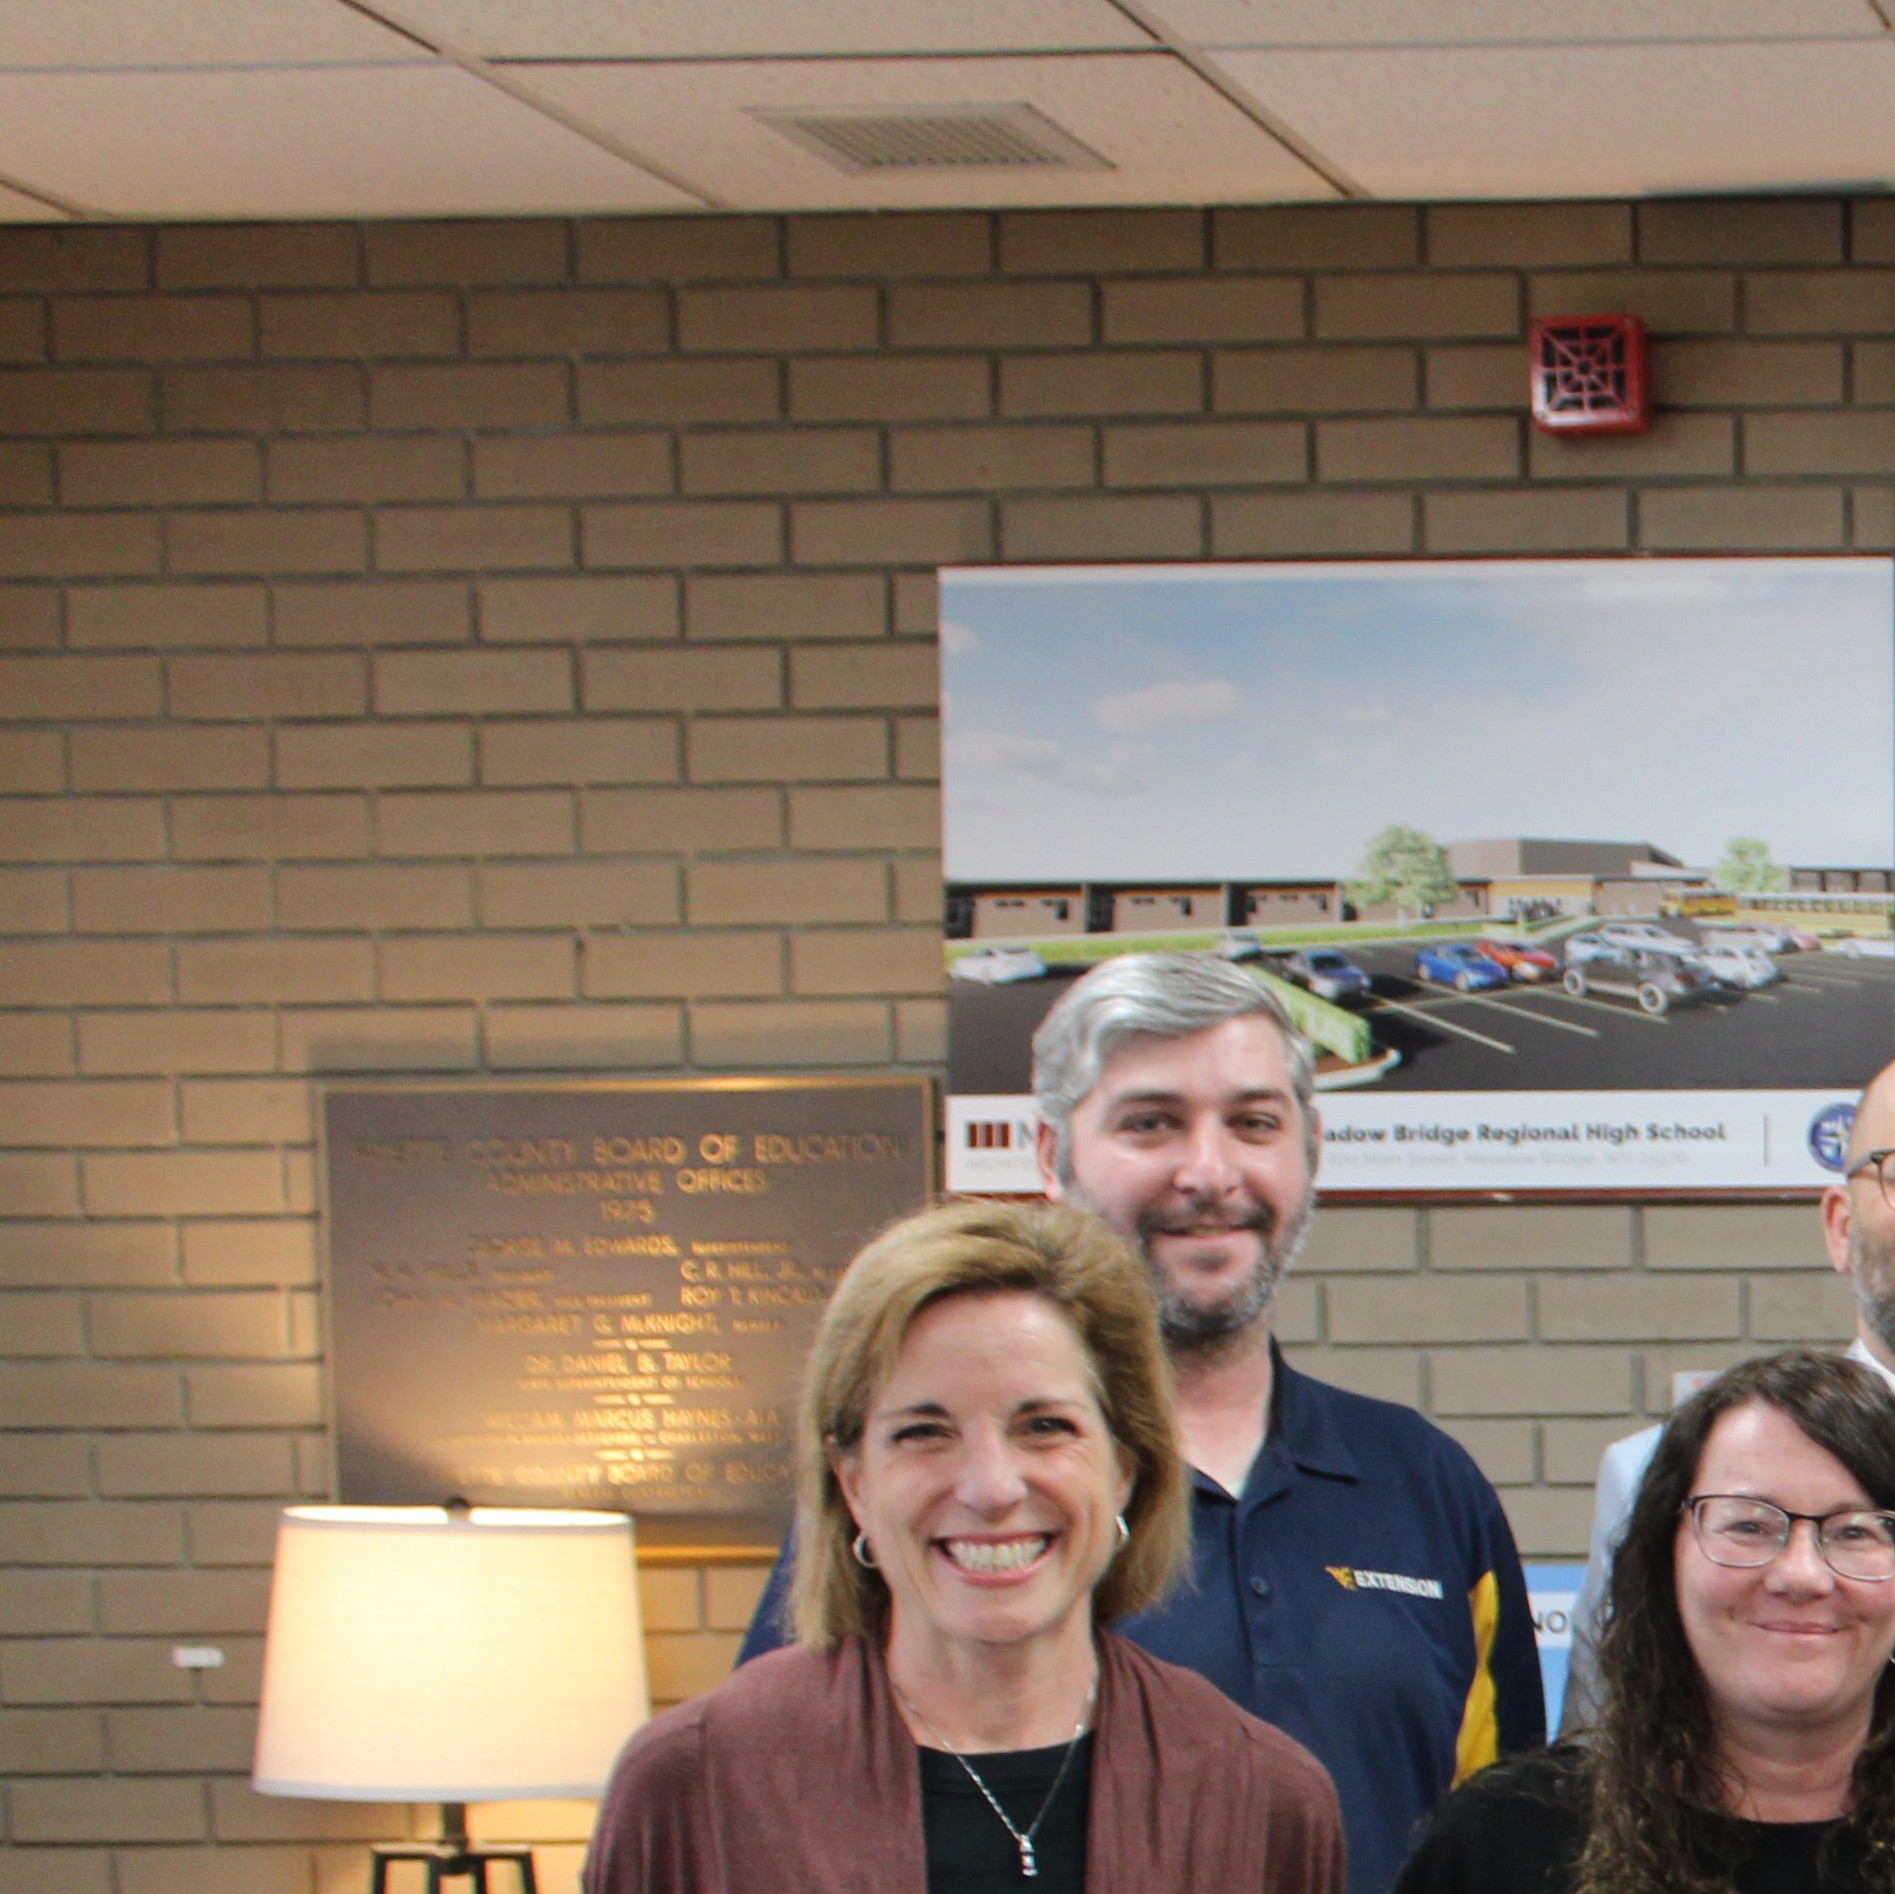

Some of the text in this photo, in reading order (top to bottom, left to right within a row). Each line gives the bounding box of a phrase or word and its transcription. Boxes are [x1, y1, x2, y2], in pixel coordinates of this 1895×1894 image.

[1393, 1121, 1470, 1146] Bridge
[1477, 1121, 1580, 1146] Regional
[1587, 1121, 1637, 1146] High
[1645, 1120, 1727, 1141] School
[592, 1136, 688, 1165] BOARD
[699, 1133, 738, 1164] OF
[676, 1168, 769, 1195] OFFICES
[663, 1352, 732, 1373] TAYLOR
[1353, 1569, 1445, 1601] EXTENSION
